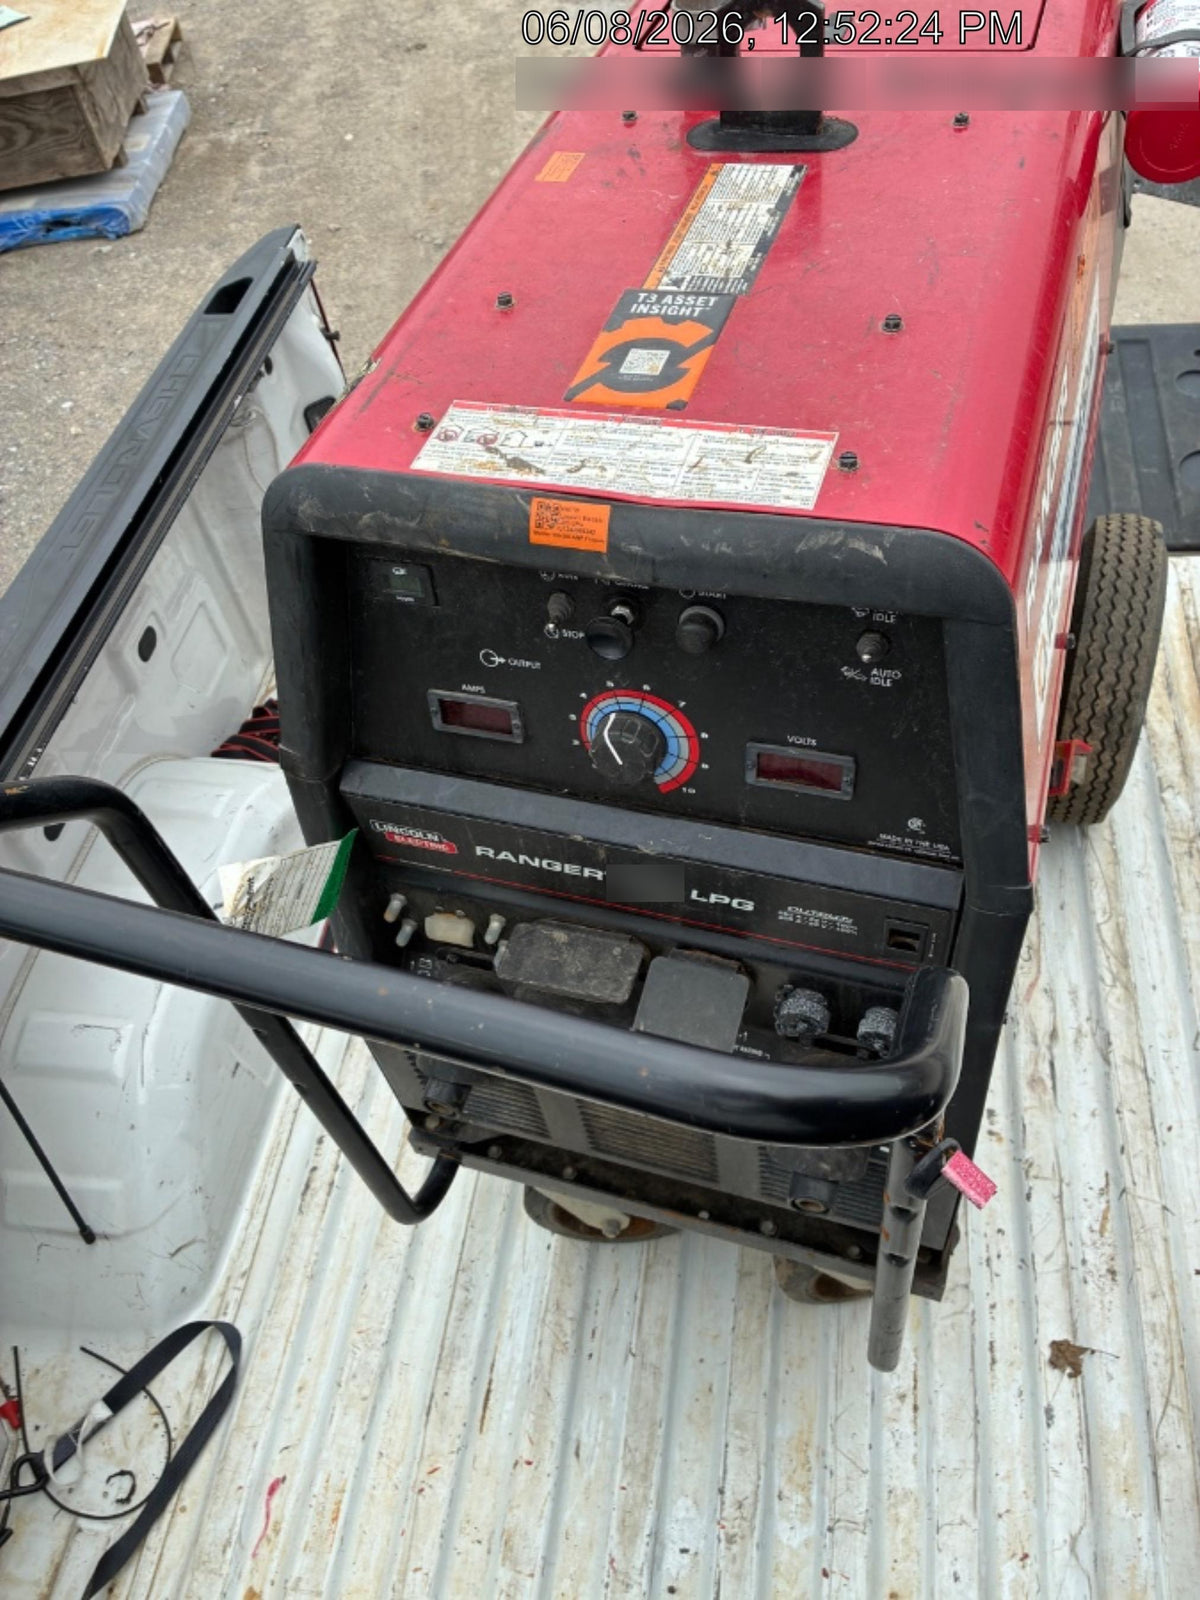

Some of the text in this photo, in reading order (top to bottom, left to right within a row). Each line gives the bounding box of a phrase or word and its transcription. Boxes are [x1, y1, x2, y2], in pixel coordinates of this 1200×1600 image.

[638, 292, 719, 306] T3 ASSET
[872, 612, 897, 624] IDLE
[562, 628, 586, 639] STOP
[870, 667, 902, 680] AUTO
[461, 683, 486, 694] AMPS
[869, 677, 893, 687] IDLE
[787, 734, 818, 747] VOLTS
[373, 822, 440, 842] LINCOLN
[475, 845, 755, 912] RANGER LPG
